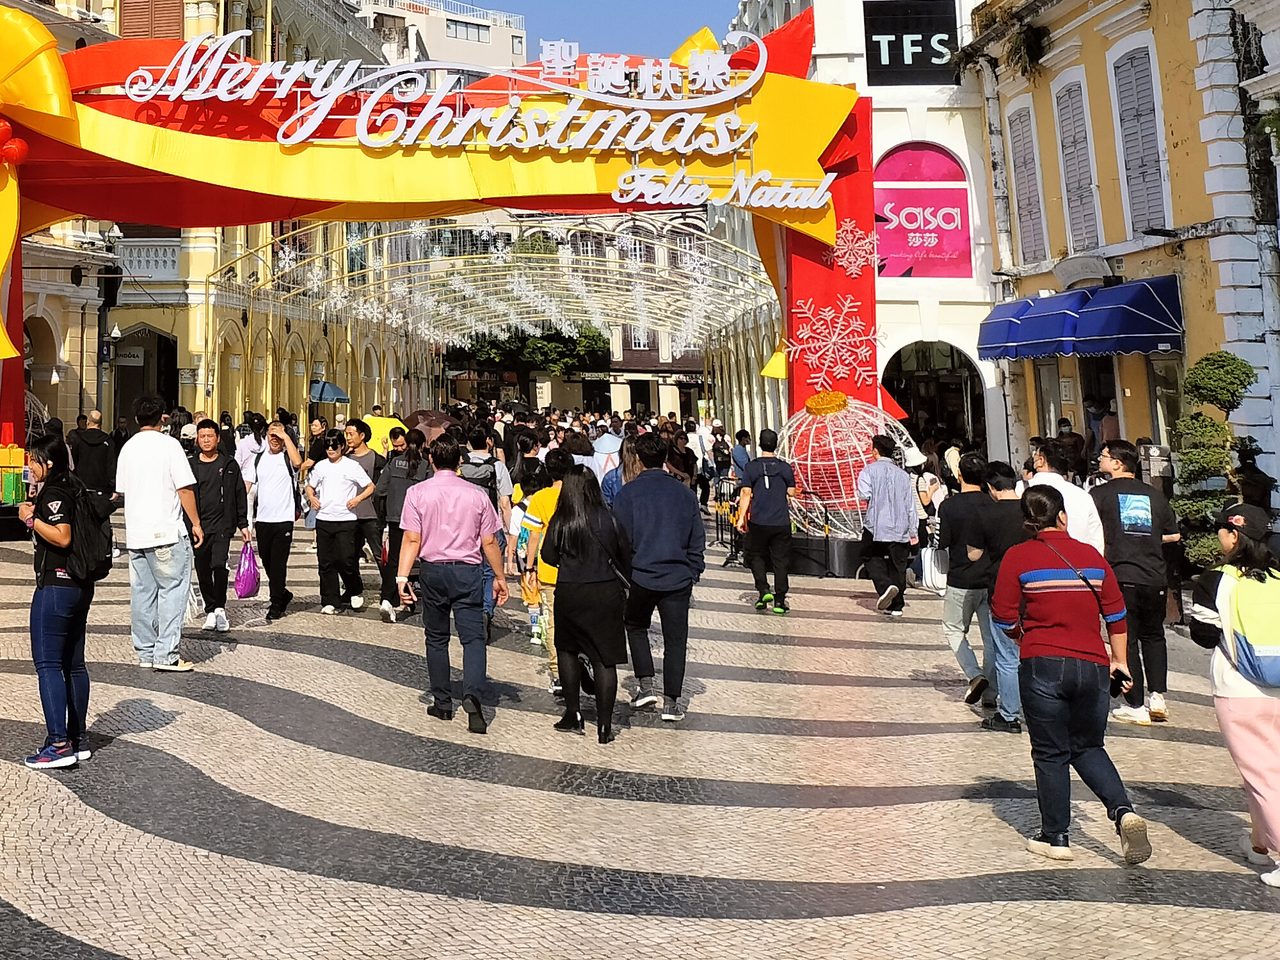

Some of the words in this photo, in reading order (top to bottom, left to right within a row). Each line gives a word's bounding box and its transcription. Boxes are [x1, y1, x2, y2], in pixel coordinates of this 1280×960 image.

[538, 37, 732, 101] 聖誕快樂
[872, 33, 952, 65] TFS
[124, 29, 362, 145] Merry
[356, 73, 758, 155] Christmas
[611, 166, 711, 205] Feliz
[712, 169, 838, 209] Natal
[907, 232, 939, 247] 莎莎
